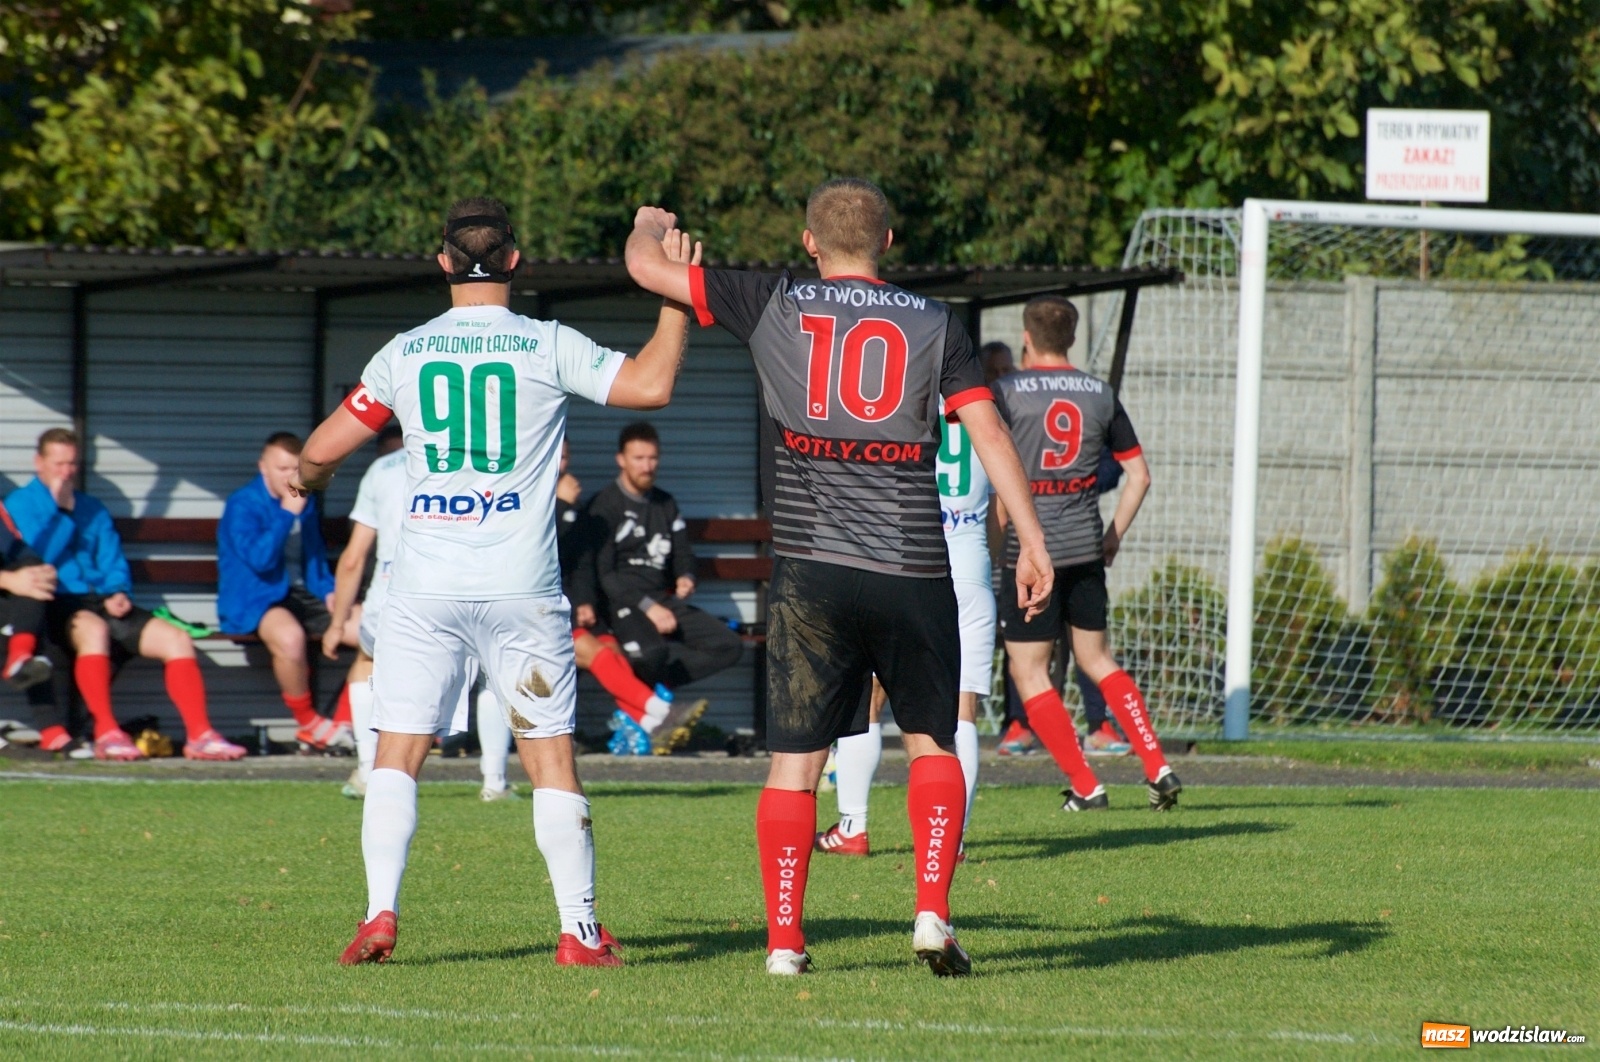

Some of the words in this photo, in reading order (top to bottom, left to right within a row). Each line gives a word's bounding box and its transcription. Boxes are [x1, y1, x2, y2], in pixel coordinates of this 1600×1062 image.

[1376, 121, 1413, 140] TEREN
[1417, 122, 1480, 141] PRYWATNY
[1403, 146, 1455, 165] ZAKAZ!
[822, 285, 927, 310] TWORKÓW
[426, 335, 483, 354] POLONIA
[487, 334, 539, 354] ŁAZISKA
[799, 311, 909, 423] 10
[351, 387, 375, 412] C
[1014, 376, 1038, 392] LKS
[1039, 376, 1103, 394] TWORKÓW
[418, 361, 516, 474] 90
[1040, 398, 1083, 470] 9
[784, 428, 922, 463] KOTLY.COM
[410, 487, 521, 527] moya
[923, 806, 949, 883] TWORKÓW
[777, 847, 798, 926] TWORKÓW
